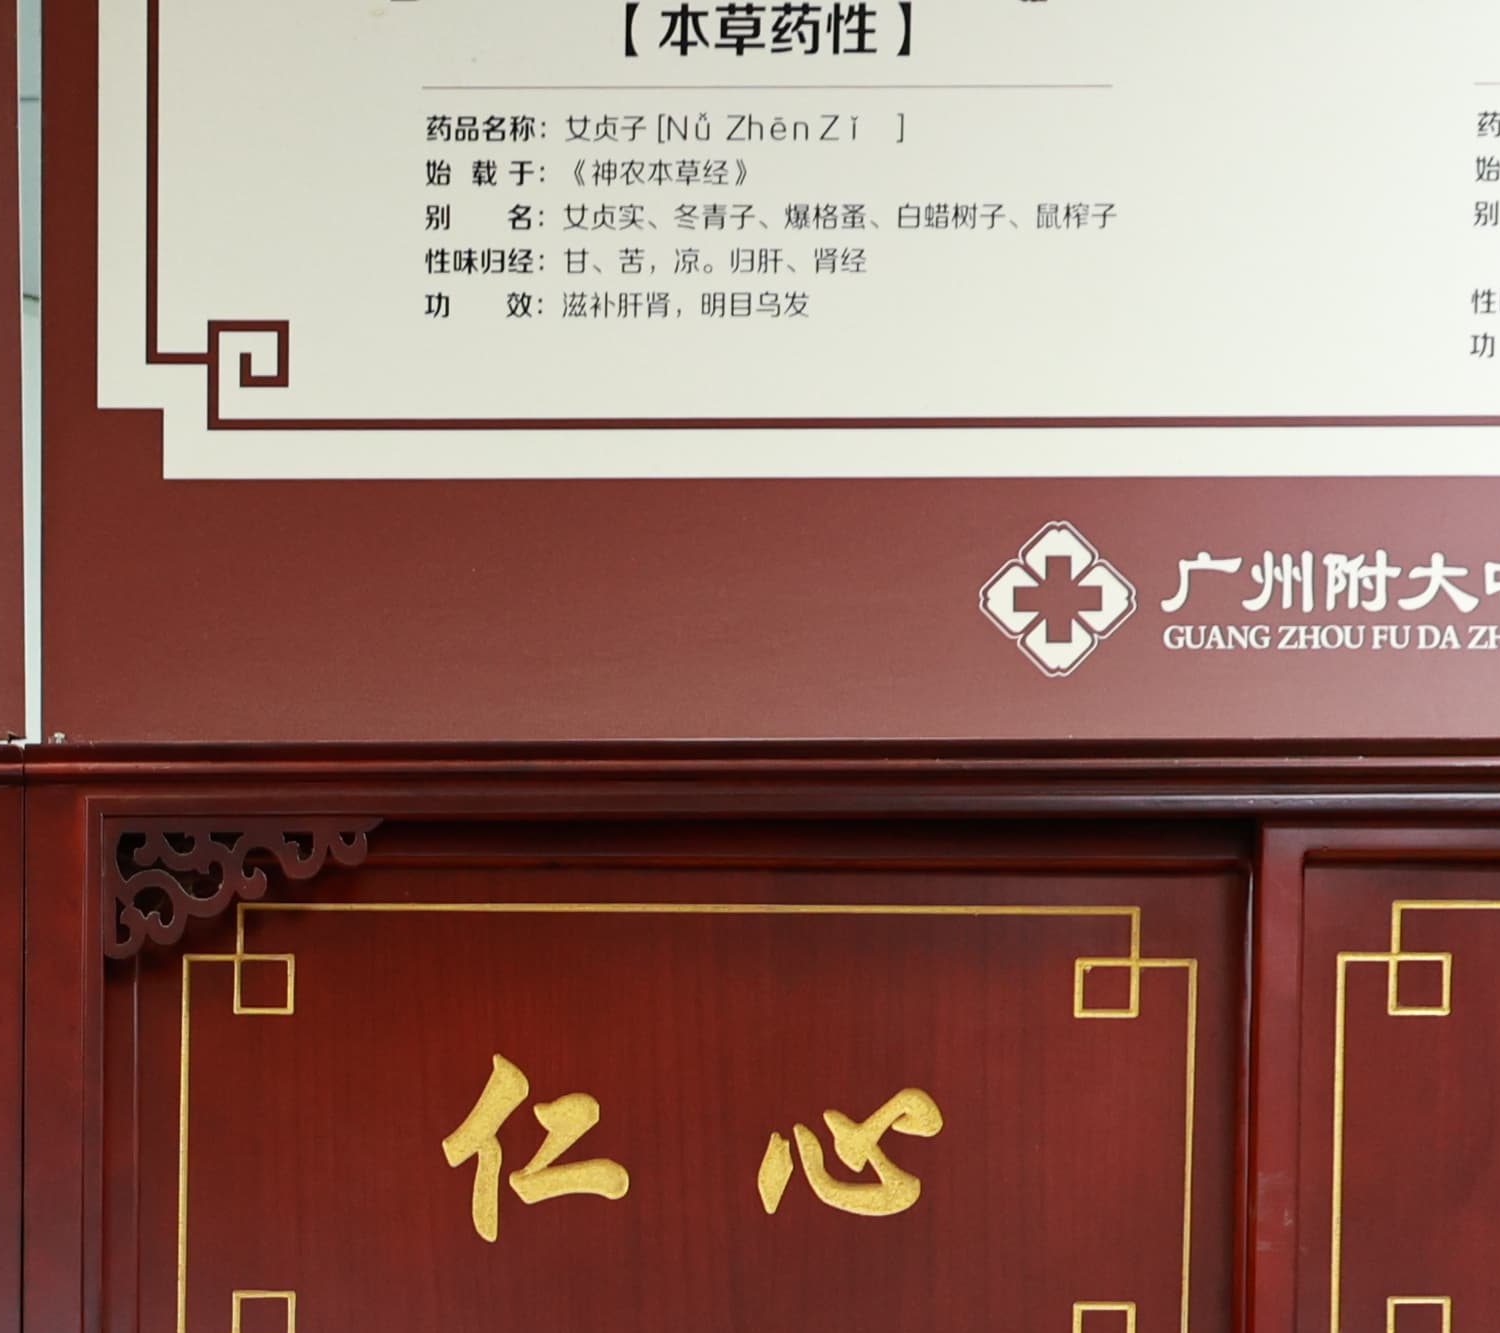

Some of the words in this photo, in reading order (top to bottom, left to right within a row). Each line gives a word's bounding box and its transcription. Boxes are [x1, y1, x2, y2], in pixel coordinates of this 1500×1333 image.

[1163, 625, 1271, 649] GUANG
[1277, 624, 1366, 650] ZHOU
[1372, 625, 1411, 650] FU
[1417, 625, 1461, 650] DA
